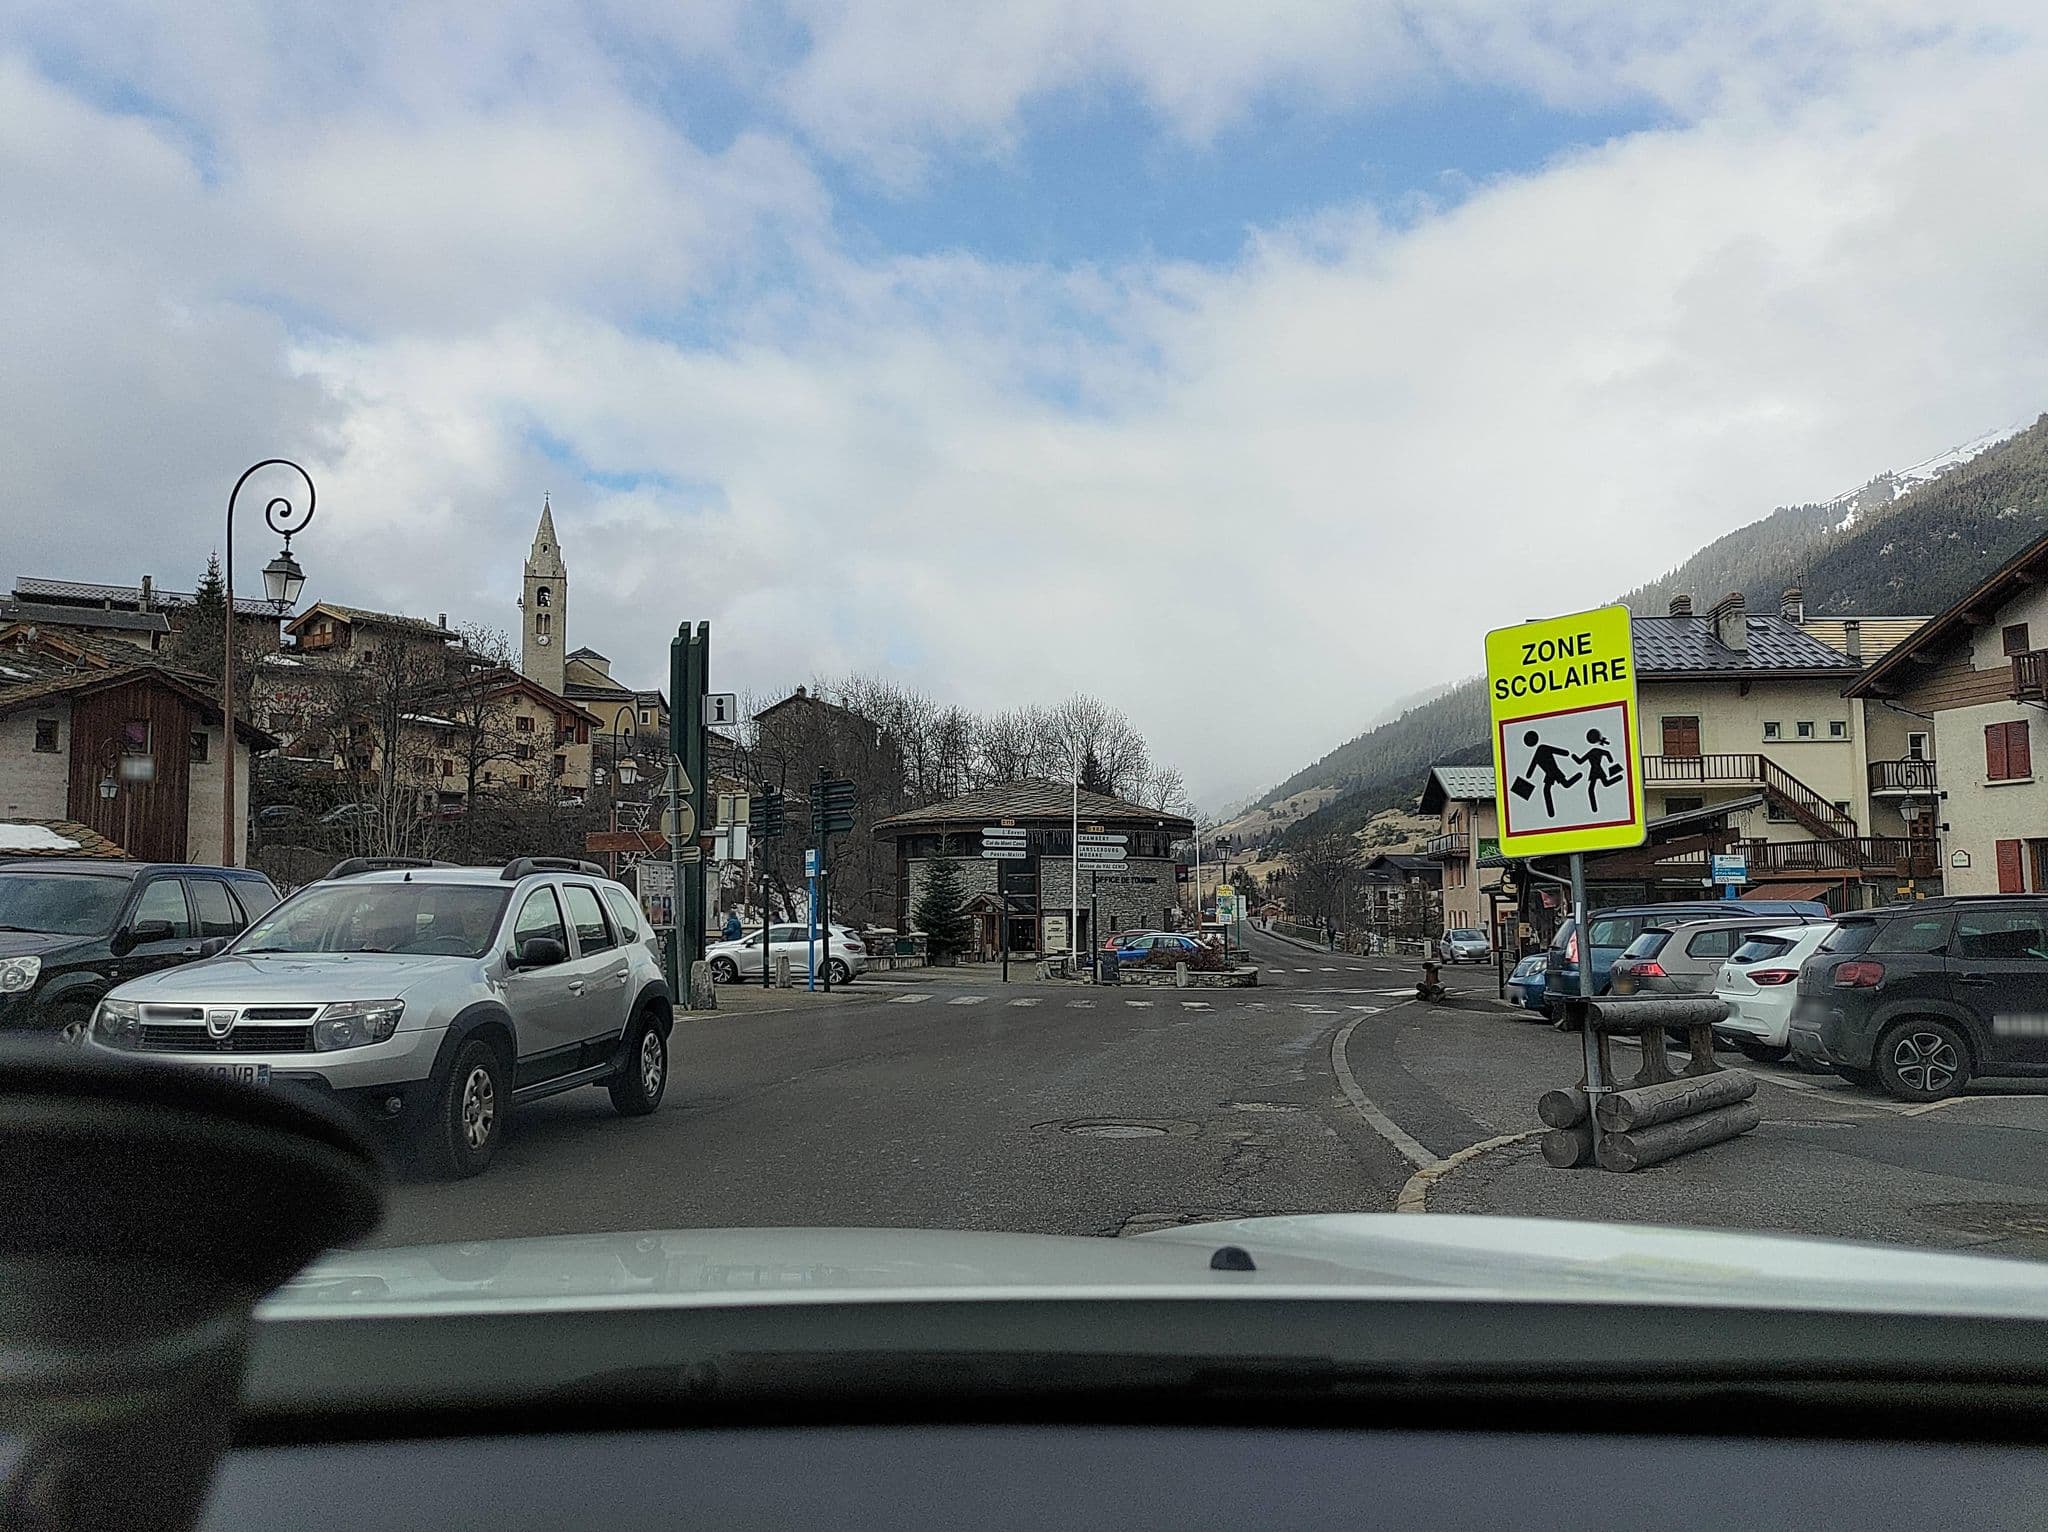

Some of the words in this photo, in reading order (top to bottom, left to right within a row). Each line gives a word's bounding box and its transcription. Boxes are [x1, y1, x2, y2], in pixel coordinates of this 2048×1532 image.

[1521, 632, 1593, 666] ZONE
[1495, 657, 1627, 700] SCOLAIRE
[1095, 876, 1120, 884] OFFICE
[1120, 876, 1129, 884] DE
